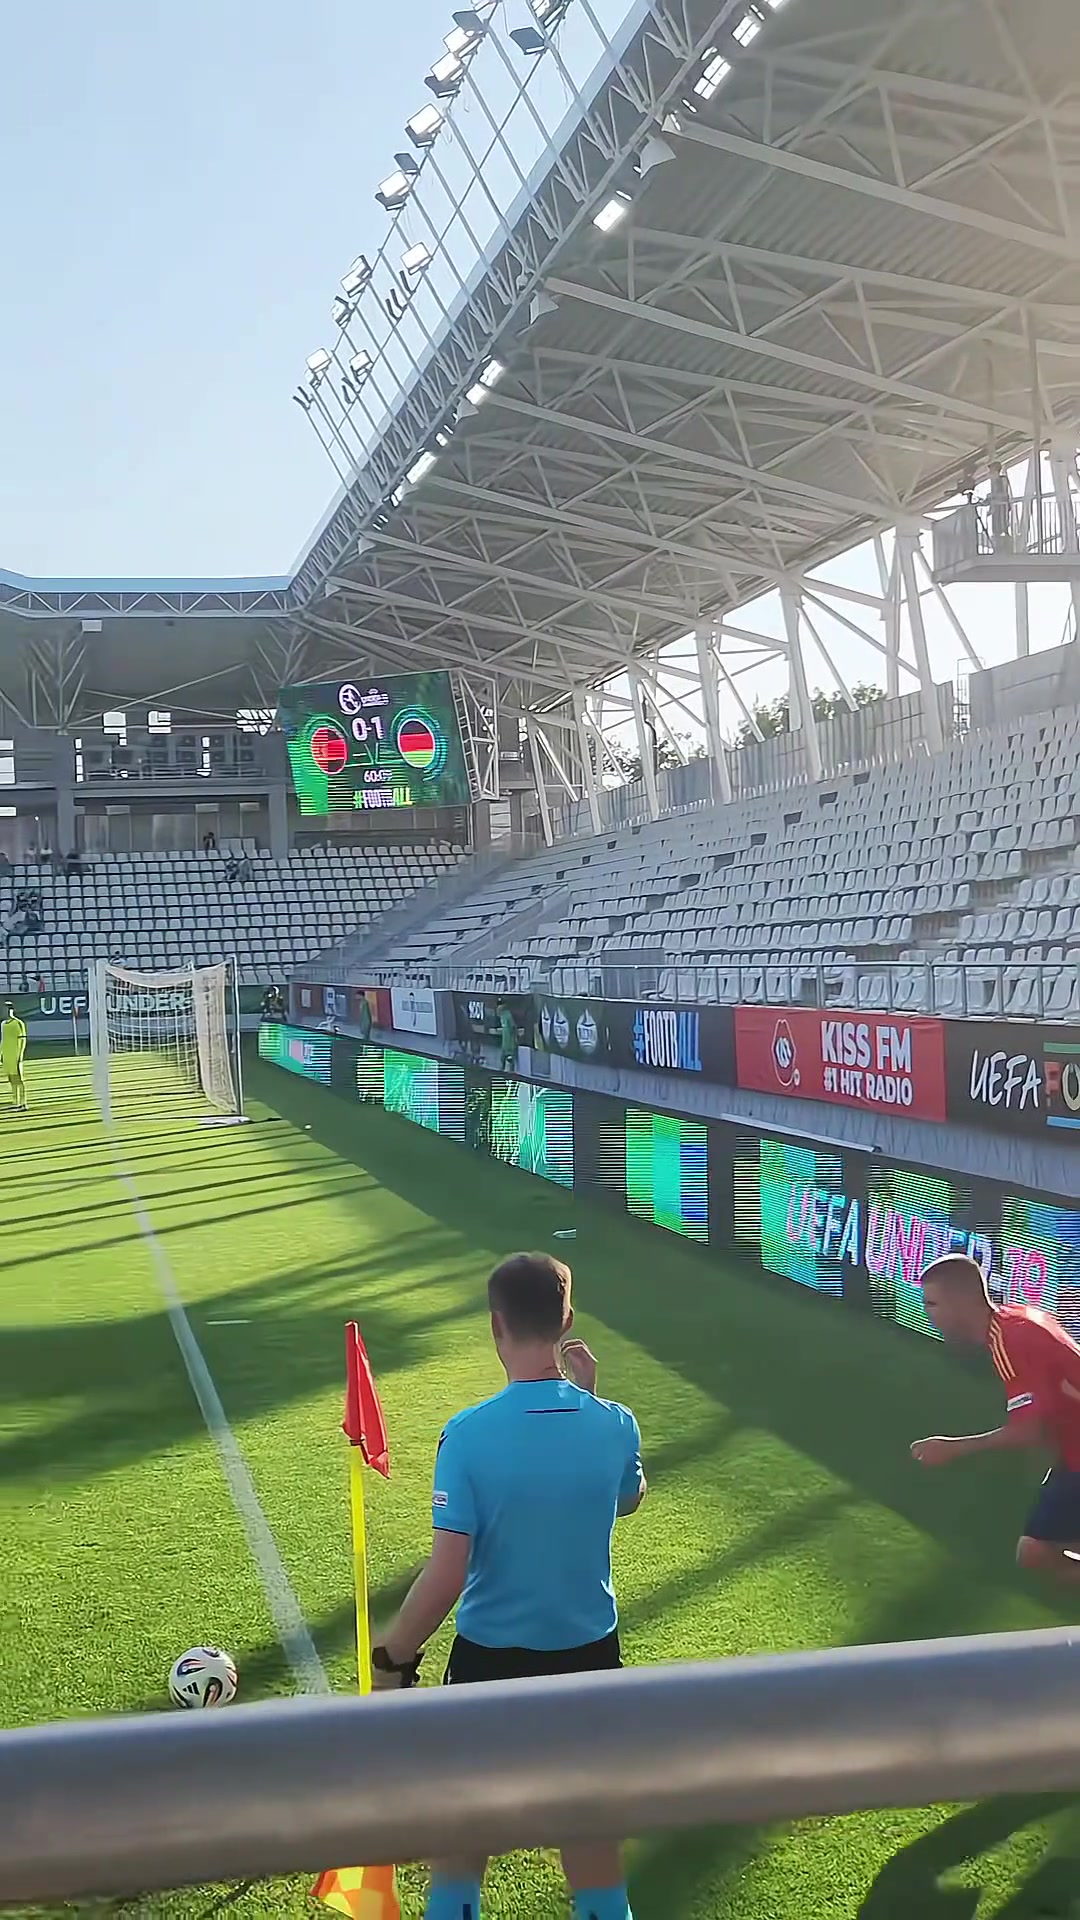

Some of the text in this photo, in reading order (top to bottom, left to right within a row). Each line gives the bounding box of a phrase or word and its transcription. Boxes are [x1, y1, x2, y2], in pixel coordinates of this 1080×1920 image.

[352, 716, 384, 741] 0-1
[353, 787, 413, 809] #FOOALL
[40, 996, 90, 1015] UEF
[821, 1020, 912, 1073] KISS FM
[824, 1066, 913, 1107] #1 HIT RADIO
[970, 1049, 1042, 1110] UEFA
[787, 1181, 862, 1267] UEFA
[866, 1206, 1048, 1305] UN-19
